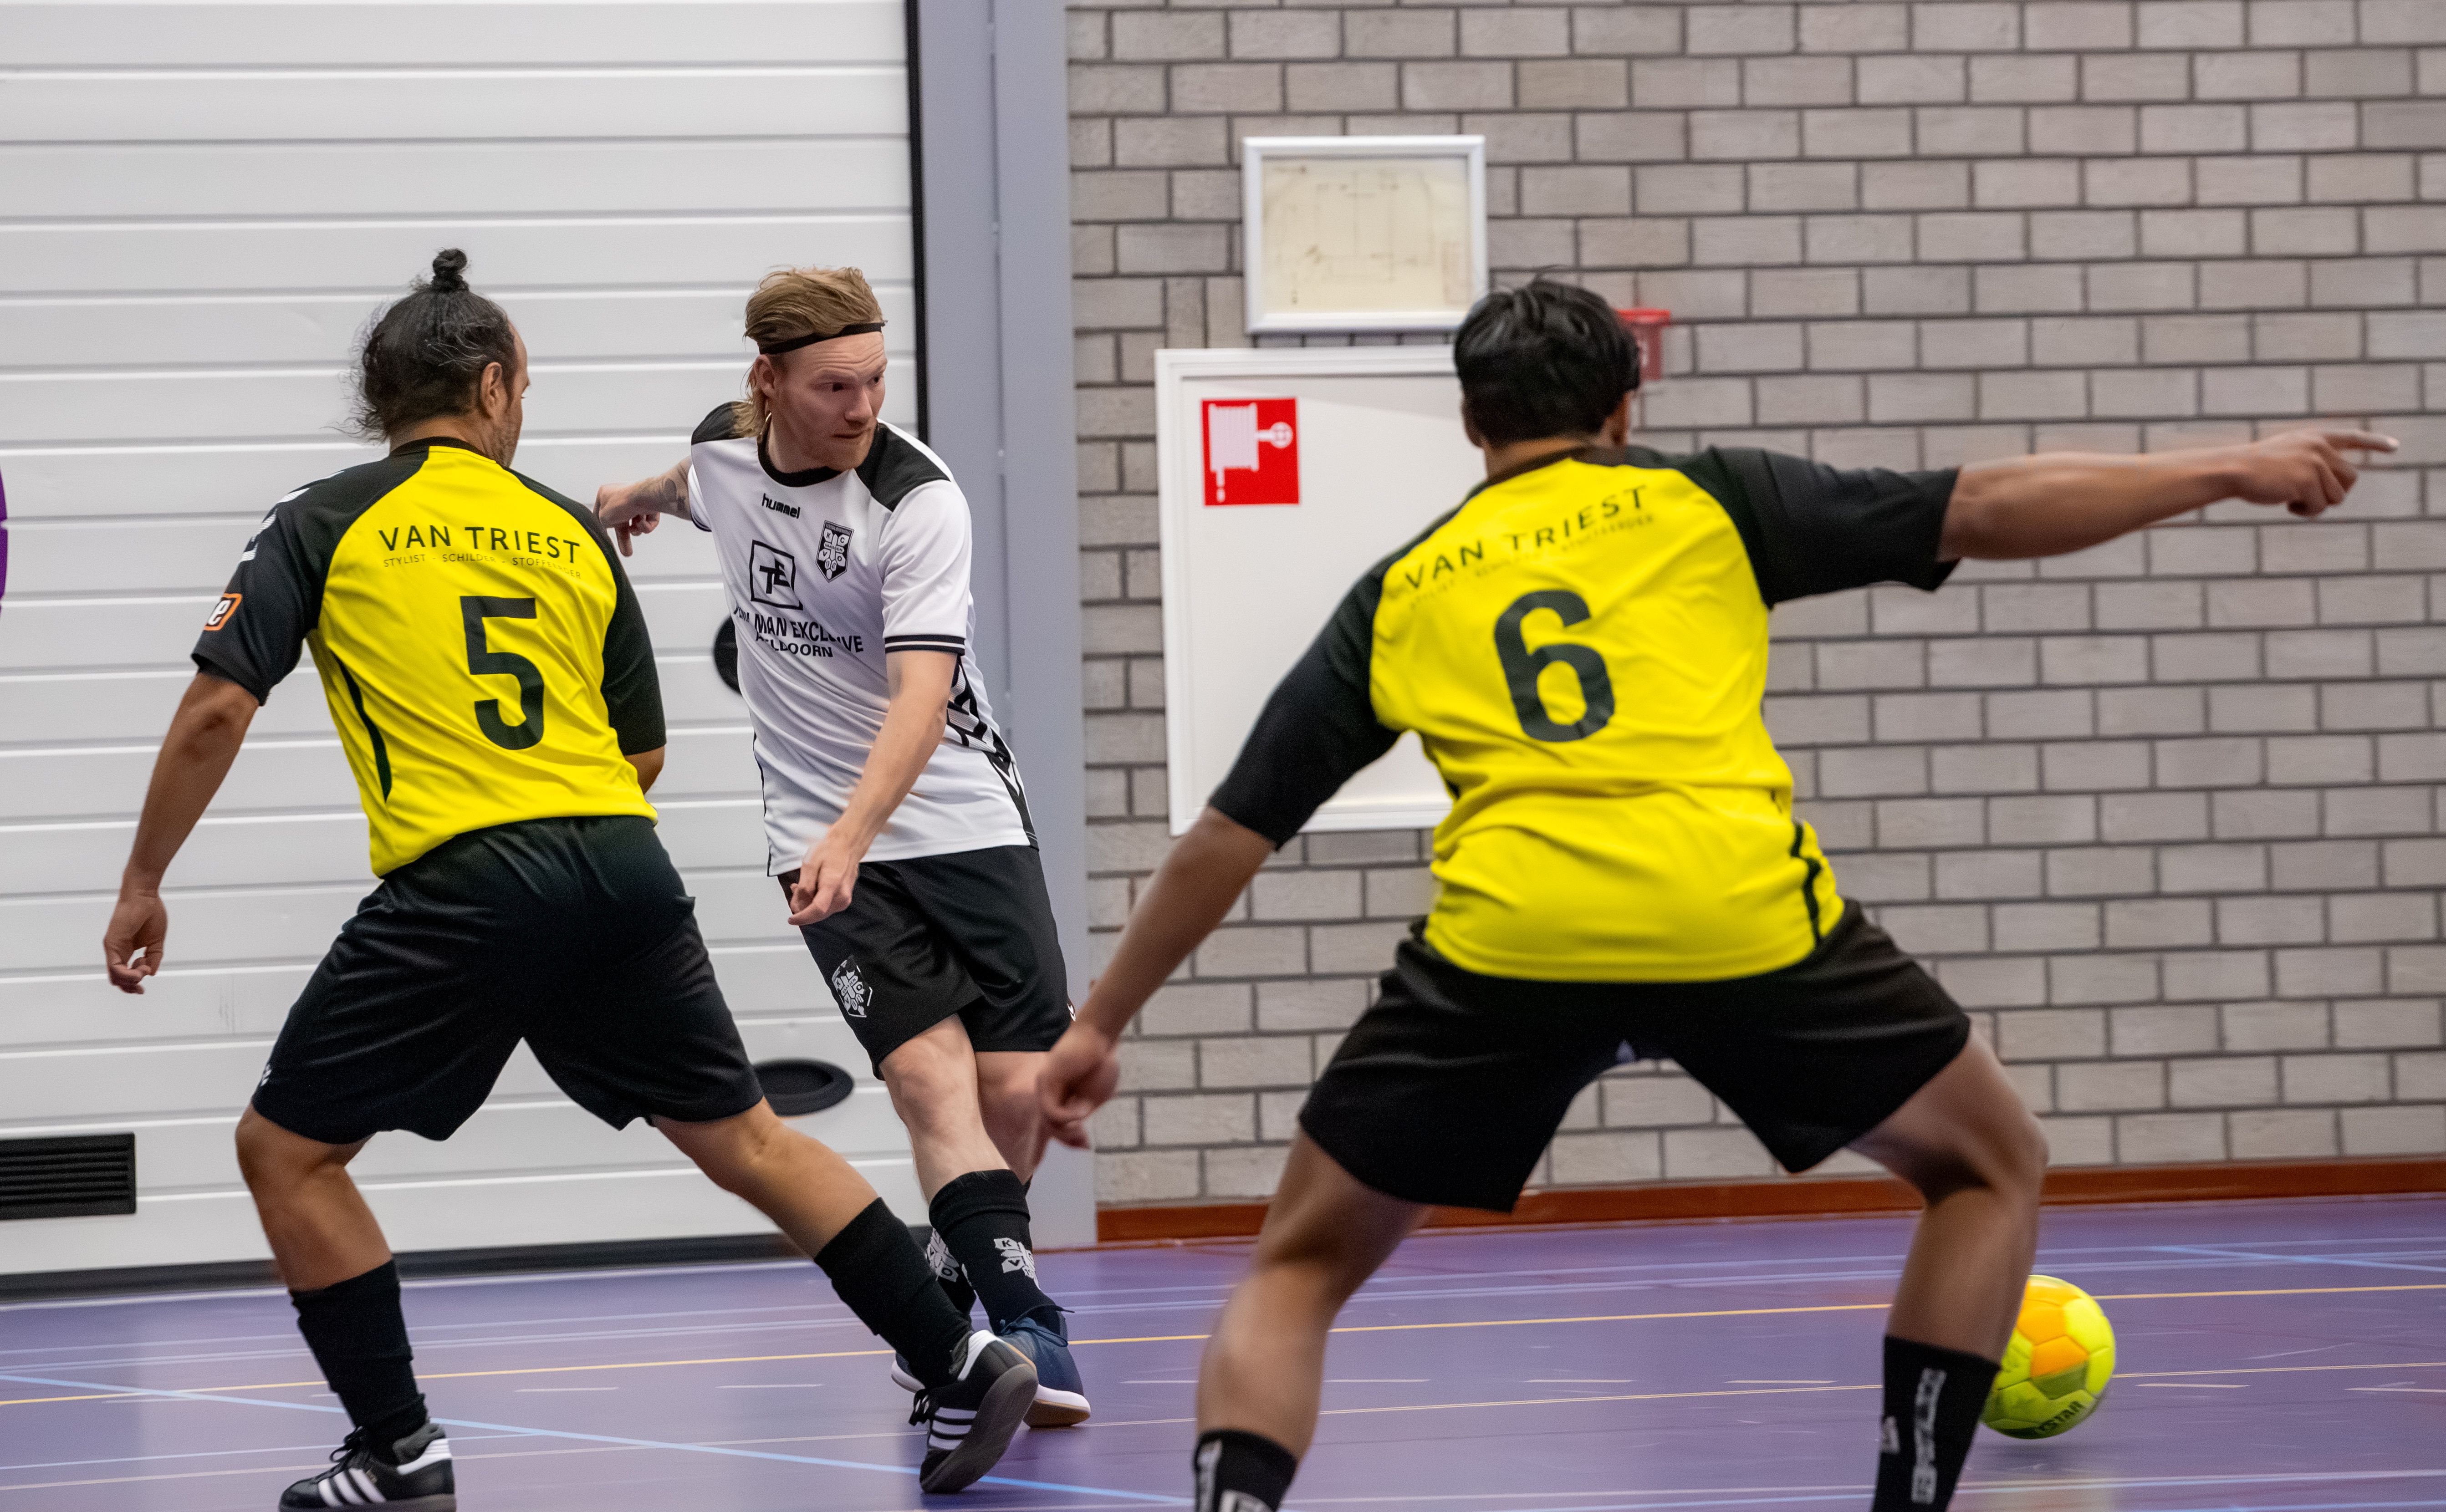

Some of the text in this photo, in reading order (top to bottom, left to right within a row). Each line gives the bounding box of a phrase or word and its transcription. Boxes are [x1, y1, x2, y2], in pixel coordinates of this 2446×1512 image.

[761, 493, 801, 519] hummel
[1404, 539, 1484, 590] VAN
[1502, 484, 1647, 550] TRIEST
[378, 524, 580, 564] VAN TRIEST
[383, 554, 426, 567] STYLIST
[442, 553, 496, 563] SCHILDER
[460, 596, 545, 750] 5
[1494, 589, 1615, 742] 6
